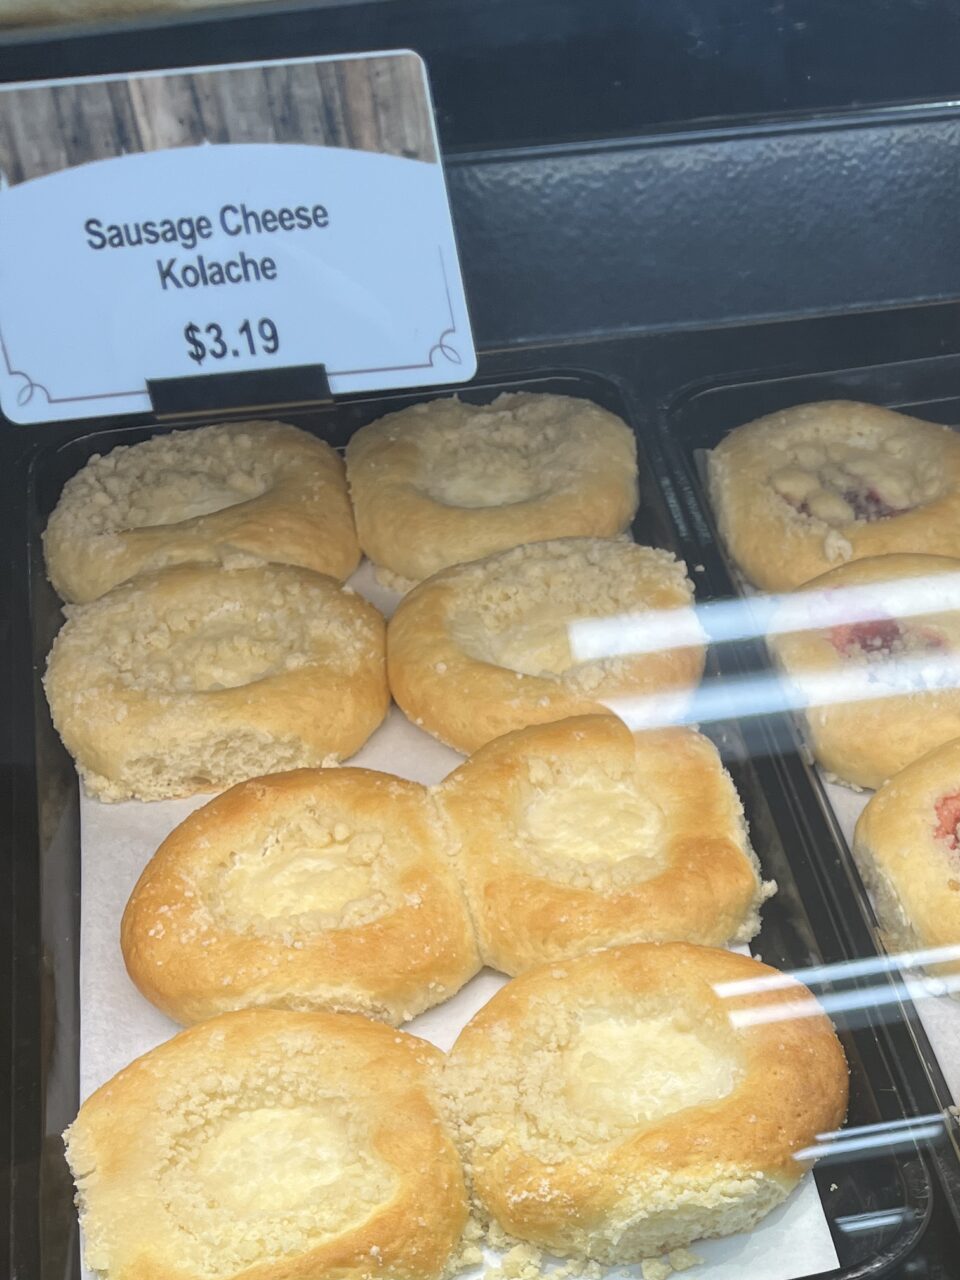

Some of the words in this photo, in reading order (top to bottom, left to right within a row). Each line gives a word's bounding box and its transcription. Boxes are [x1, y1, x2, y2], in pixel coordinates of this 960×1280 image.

[84, 213, 213, 250] Sausage
[219, 202, 330, 237] Cheese
[156, 251, 278, 290] Kolache
[183, 317, 280, 364] $3.19
